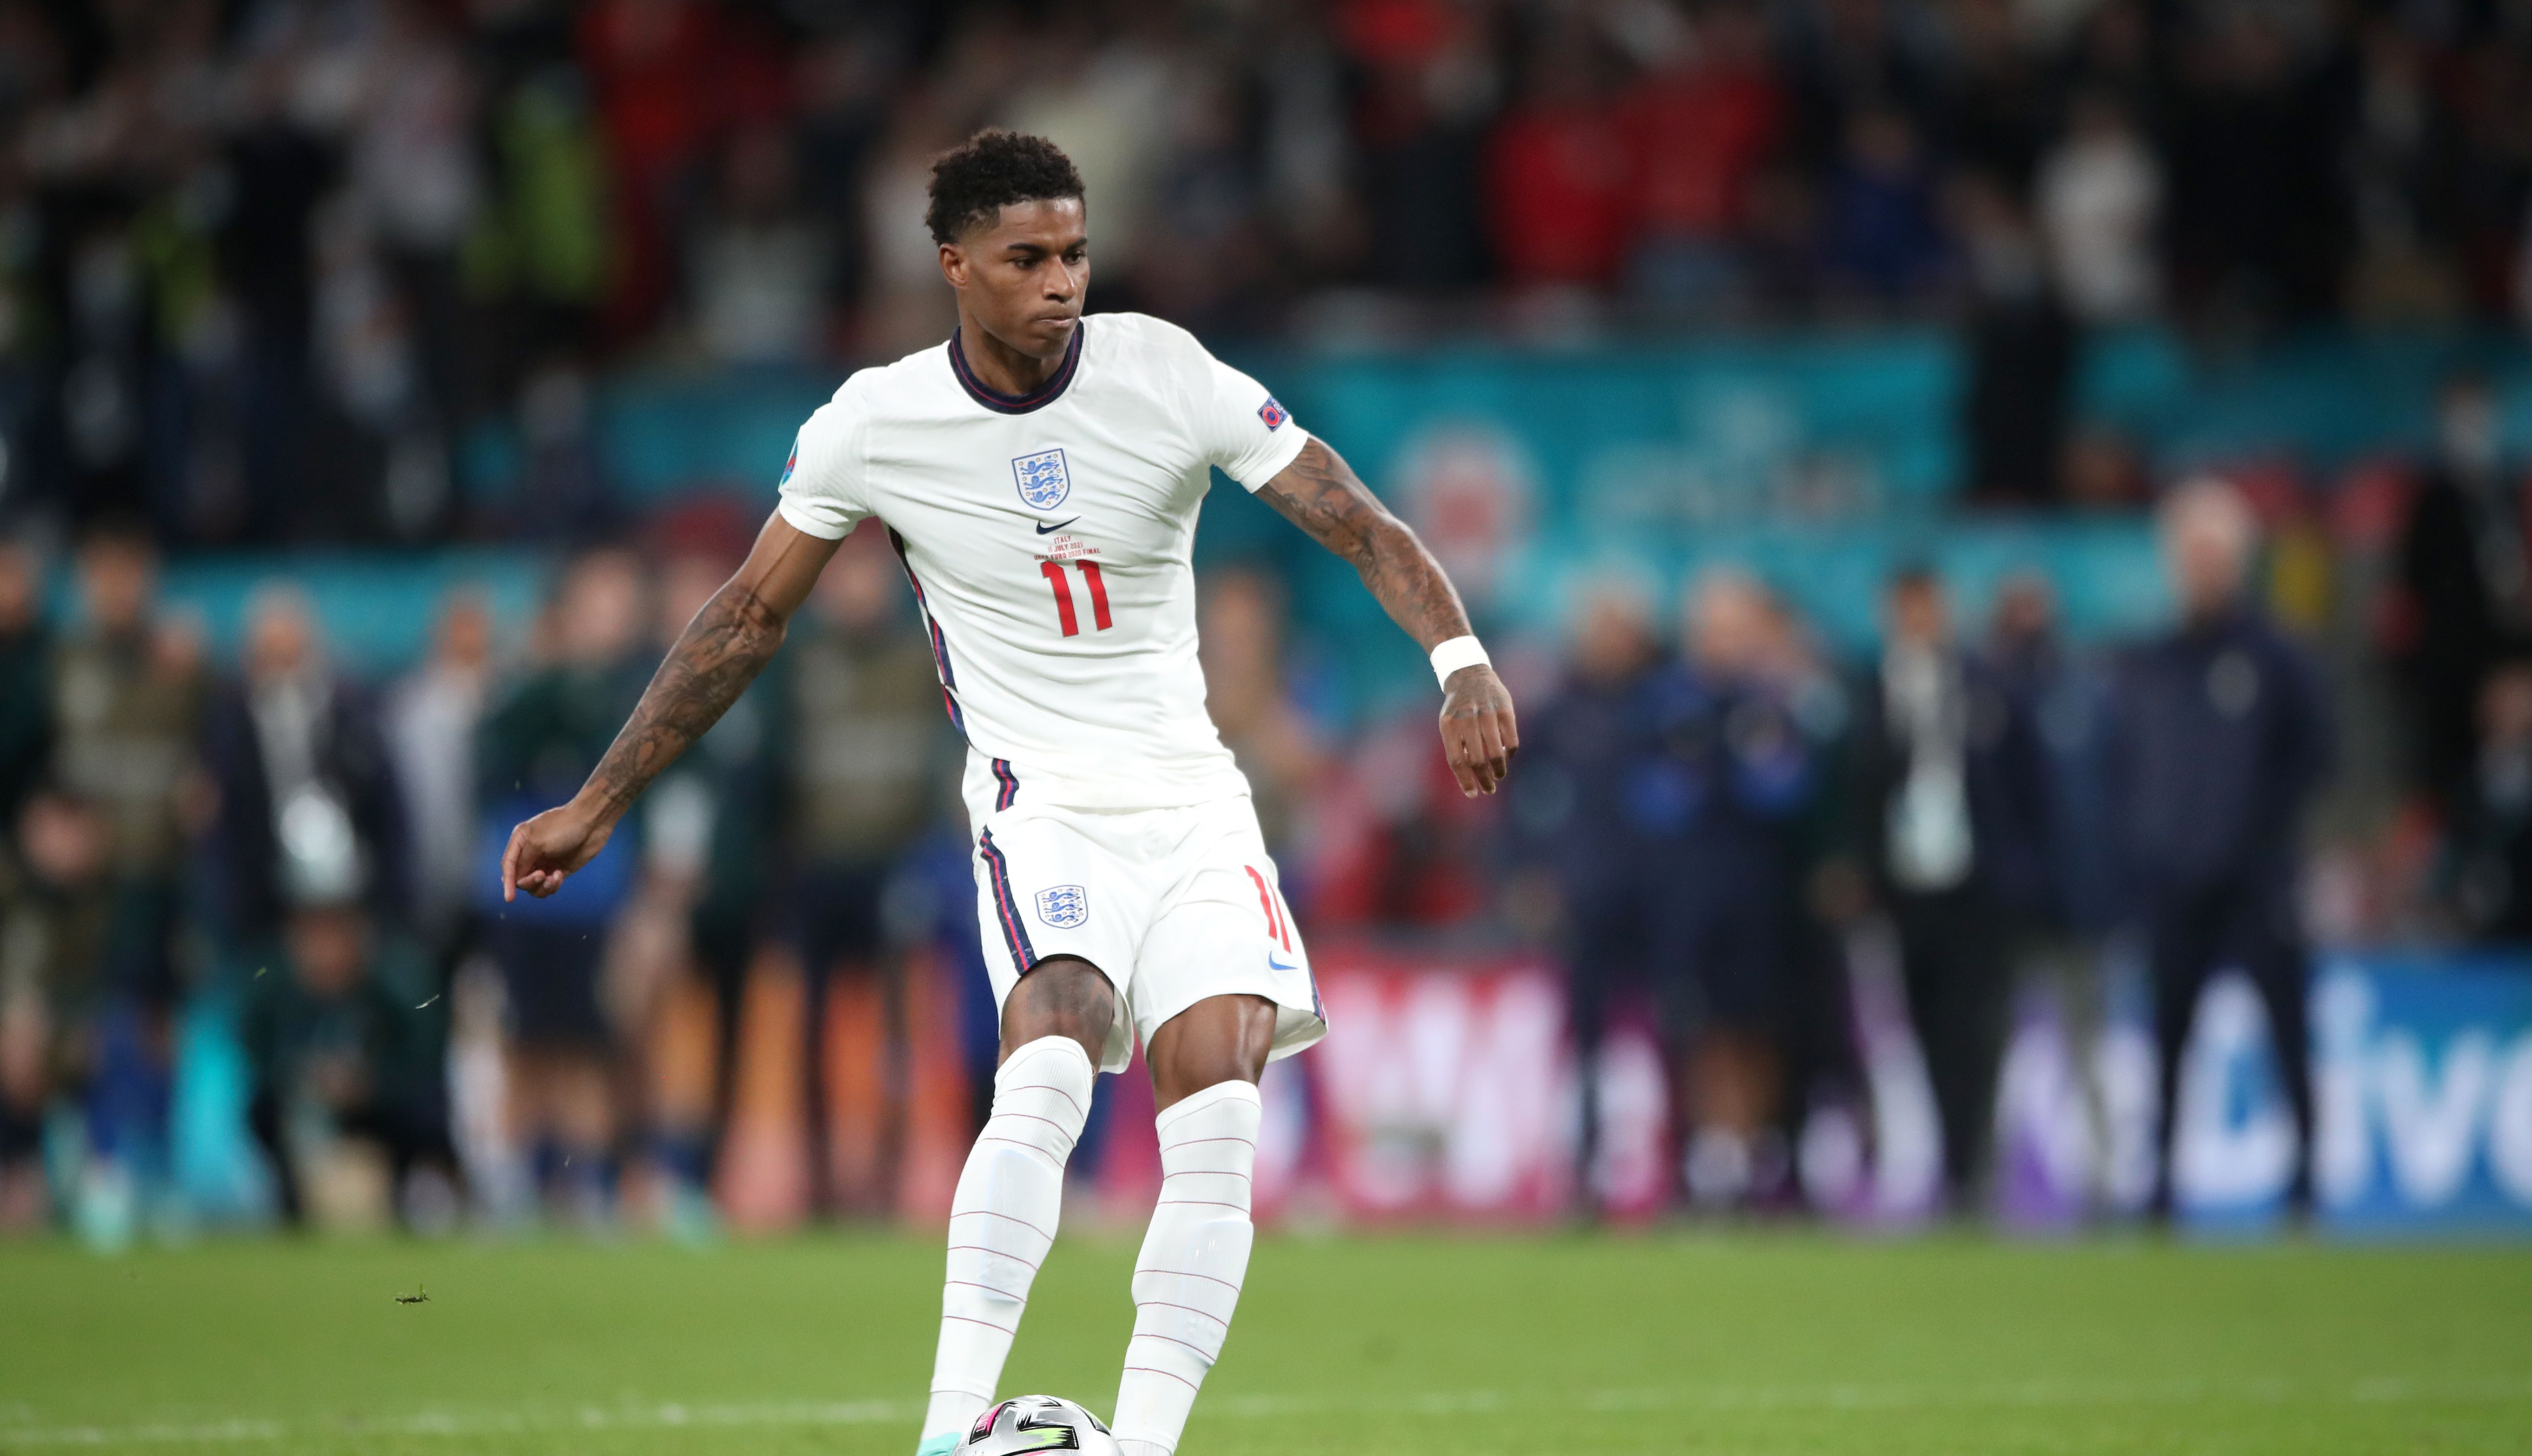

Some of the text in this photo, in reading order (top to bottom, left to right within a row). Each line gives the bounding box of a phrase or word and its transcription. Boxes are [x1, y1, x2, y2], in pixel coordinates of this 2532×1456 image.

[1054, 535, 1071, 544] ITALY
[1054, 544, 1069, 552] JULY
[1069, 550, 1082, 558] 2020
[1041, 559, 1112, 637] 11
[1244, 865, 1292, 955] 11
